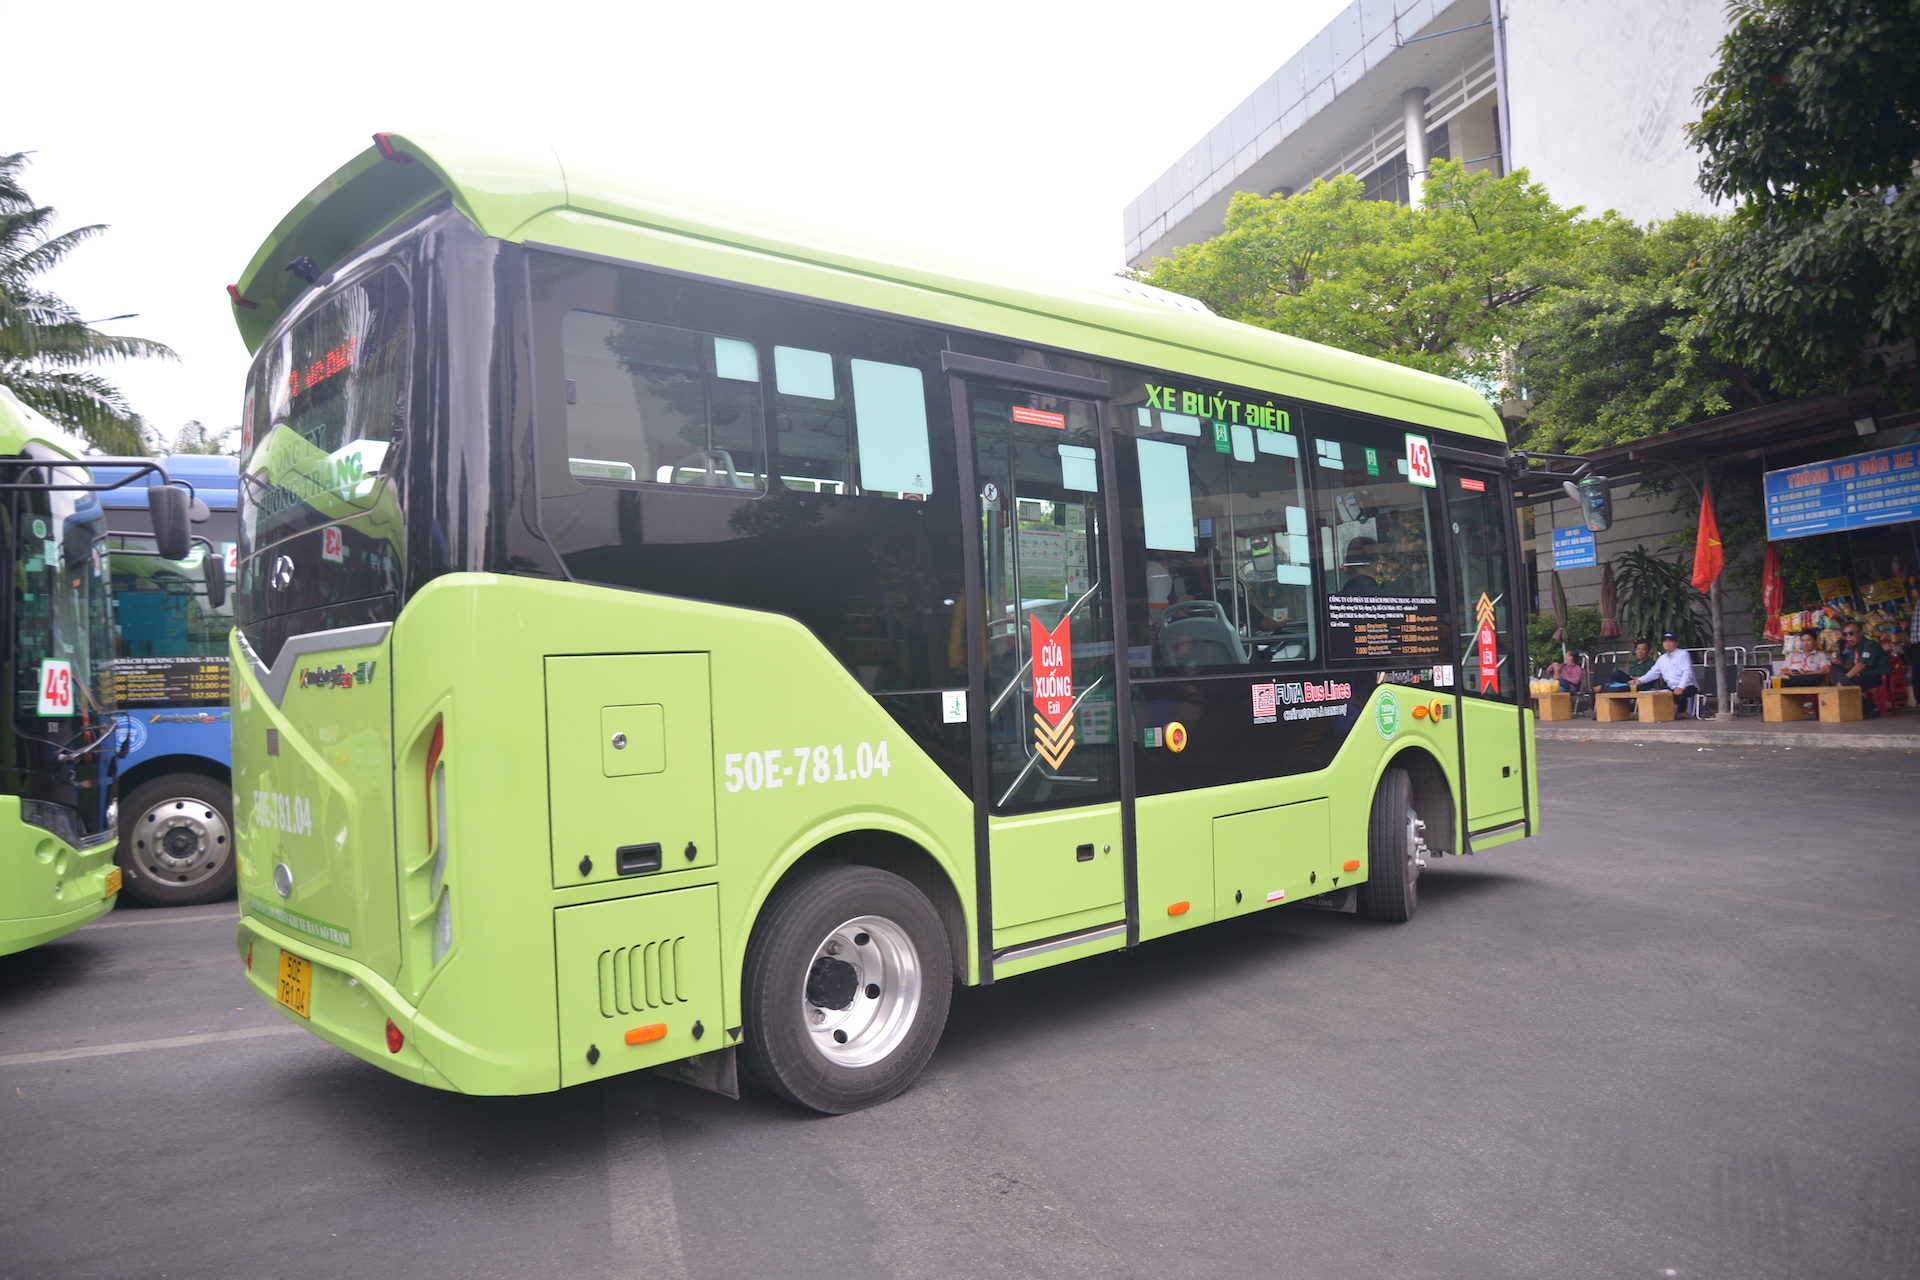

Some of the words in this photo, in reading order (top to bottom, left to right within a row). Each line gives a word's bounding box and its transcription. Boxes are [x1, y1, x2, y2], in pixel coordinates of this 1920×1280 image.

[1144, 383, 1177, 412] XE
[1182, 391, 1241, 423] BUÝT
[301, 451, 364, 500] TRANG
[582, 465, 606, 474] camera
[1410, 443, 1431, 478] 43
[1787, 467, 1829, 489] THÔNG
[1832, 463, 1855, 480] TIN
[1859, 456, 1889, 476] ĐÓN
[1893, 451, 1914, 470] XE
[1041, 639, 1063, 667] CỬA
[45, 669, 70, 707] 43
[1035, 668, 1071, 698] XUỐNG
[1275, 683, 1304, 705] FUTA
[1304, 682, 1324, 702] Bus
[1324, 680, 1351, 701] Lines
[1047, 701, 1061, 714] Exit
[725, 741, 891, 793] 50E-781.04
[254, 790, 312, 837] 50E-781.04
[329, 927, 350, 947] TRẠM
[288, 957, 301, 983] 50E
[281, 979, 306, 1013] 781.04
